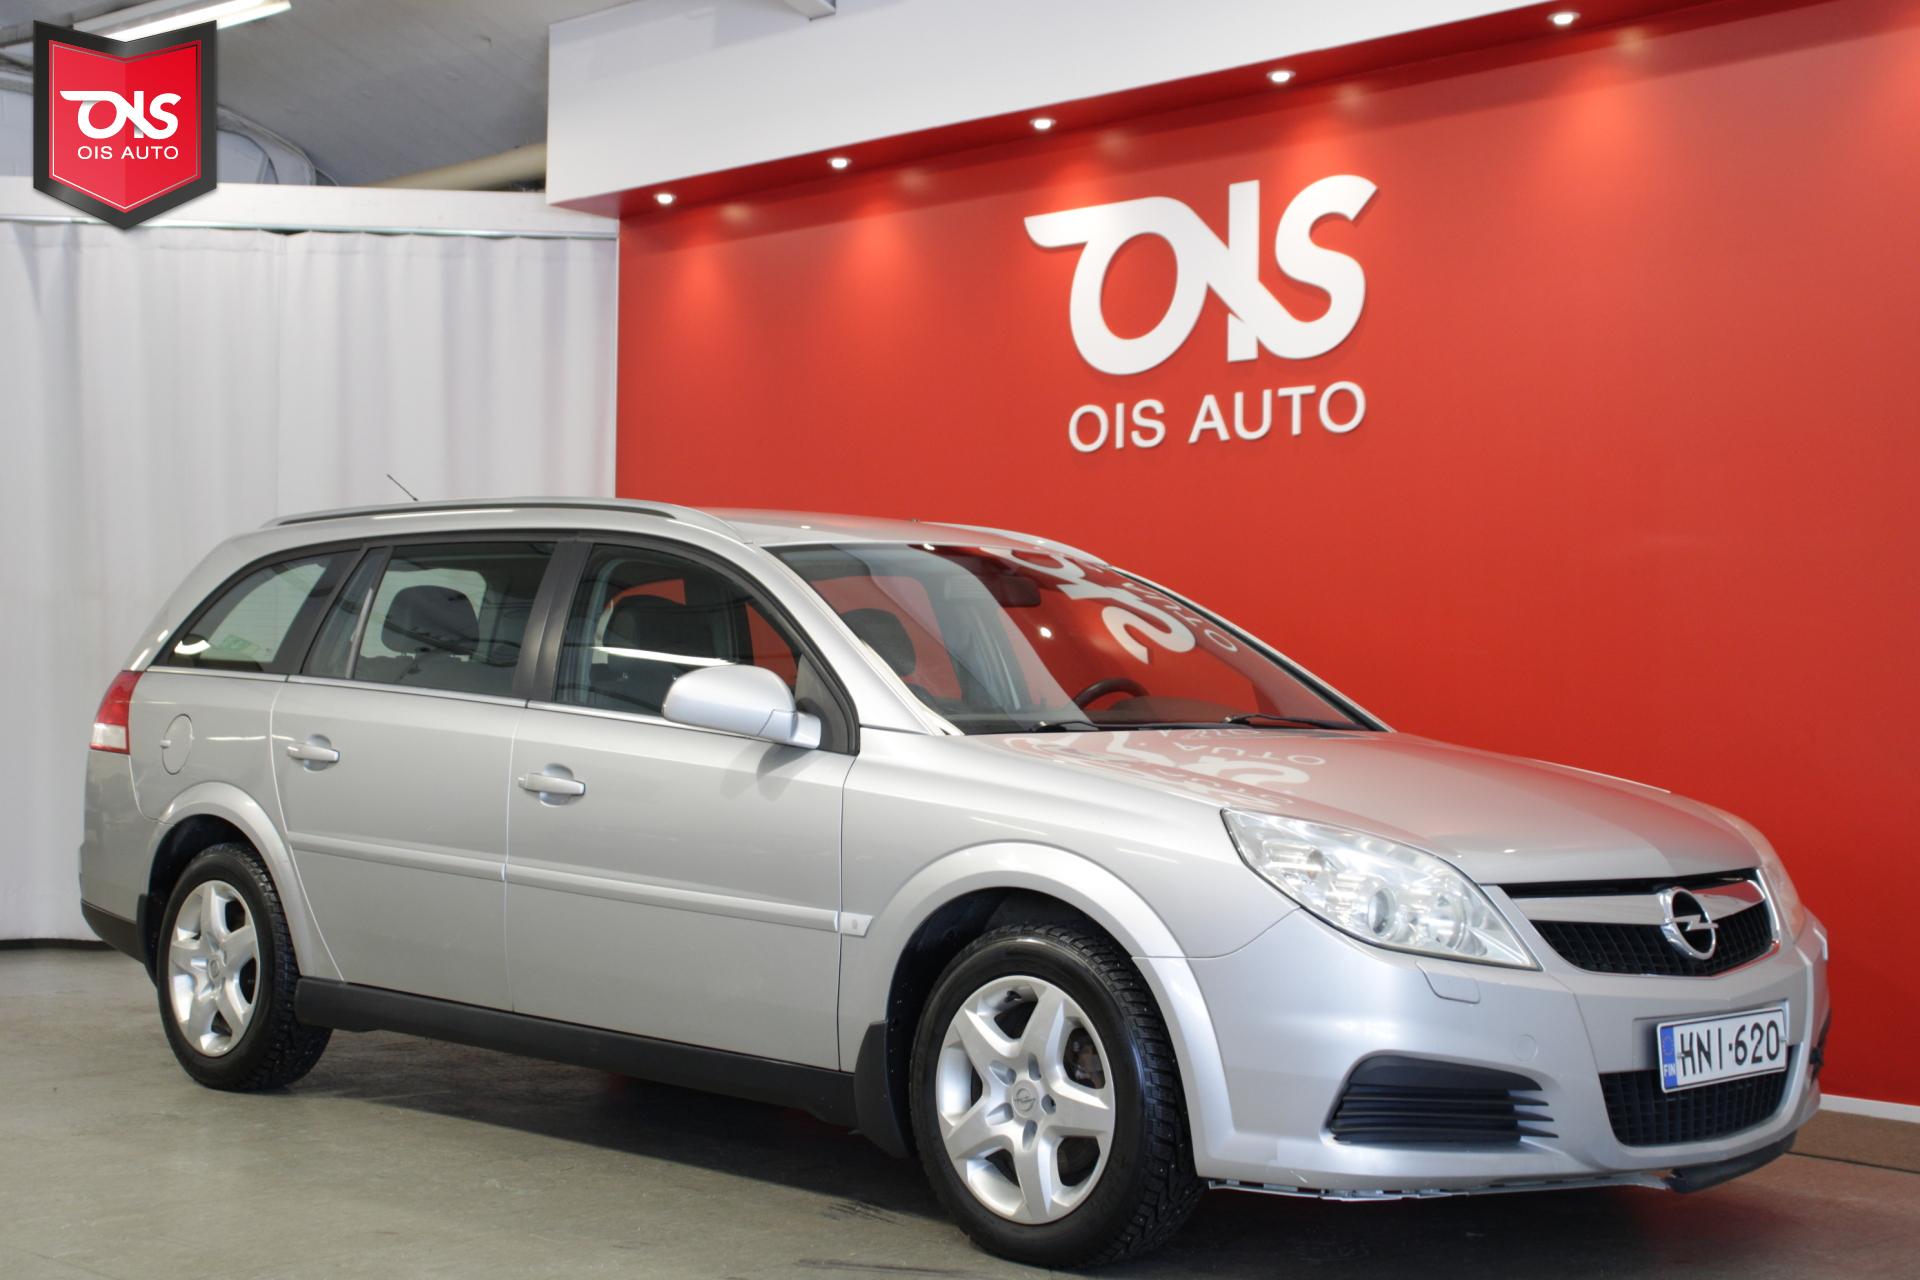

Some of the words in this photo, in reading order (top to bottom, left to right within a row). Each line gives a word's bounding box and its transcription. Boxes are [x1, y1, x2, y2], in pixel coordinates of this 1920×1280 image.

[1024, 174, 1378, 375] OIS
[1068, 399, 1166, 453] OIS
[1188, 380, 1367, 444] AUTO
[1663, 1063, 1677, 1077] FIN
